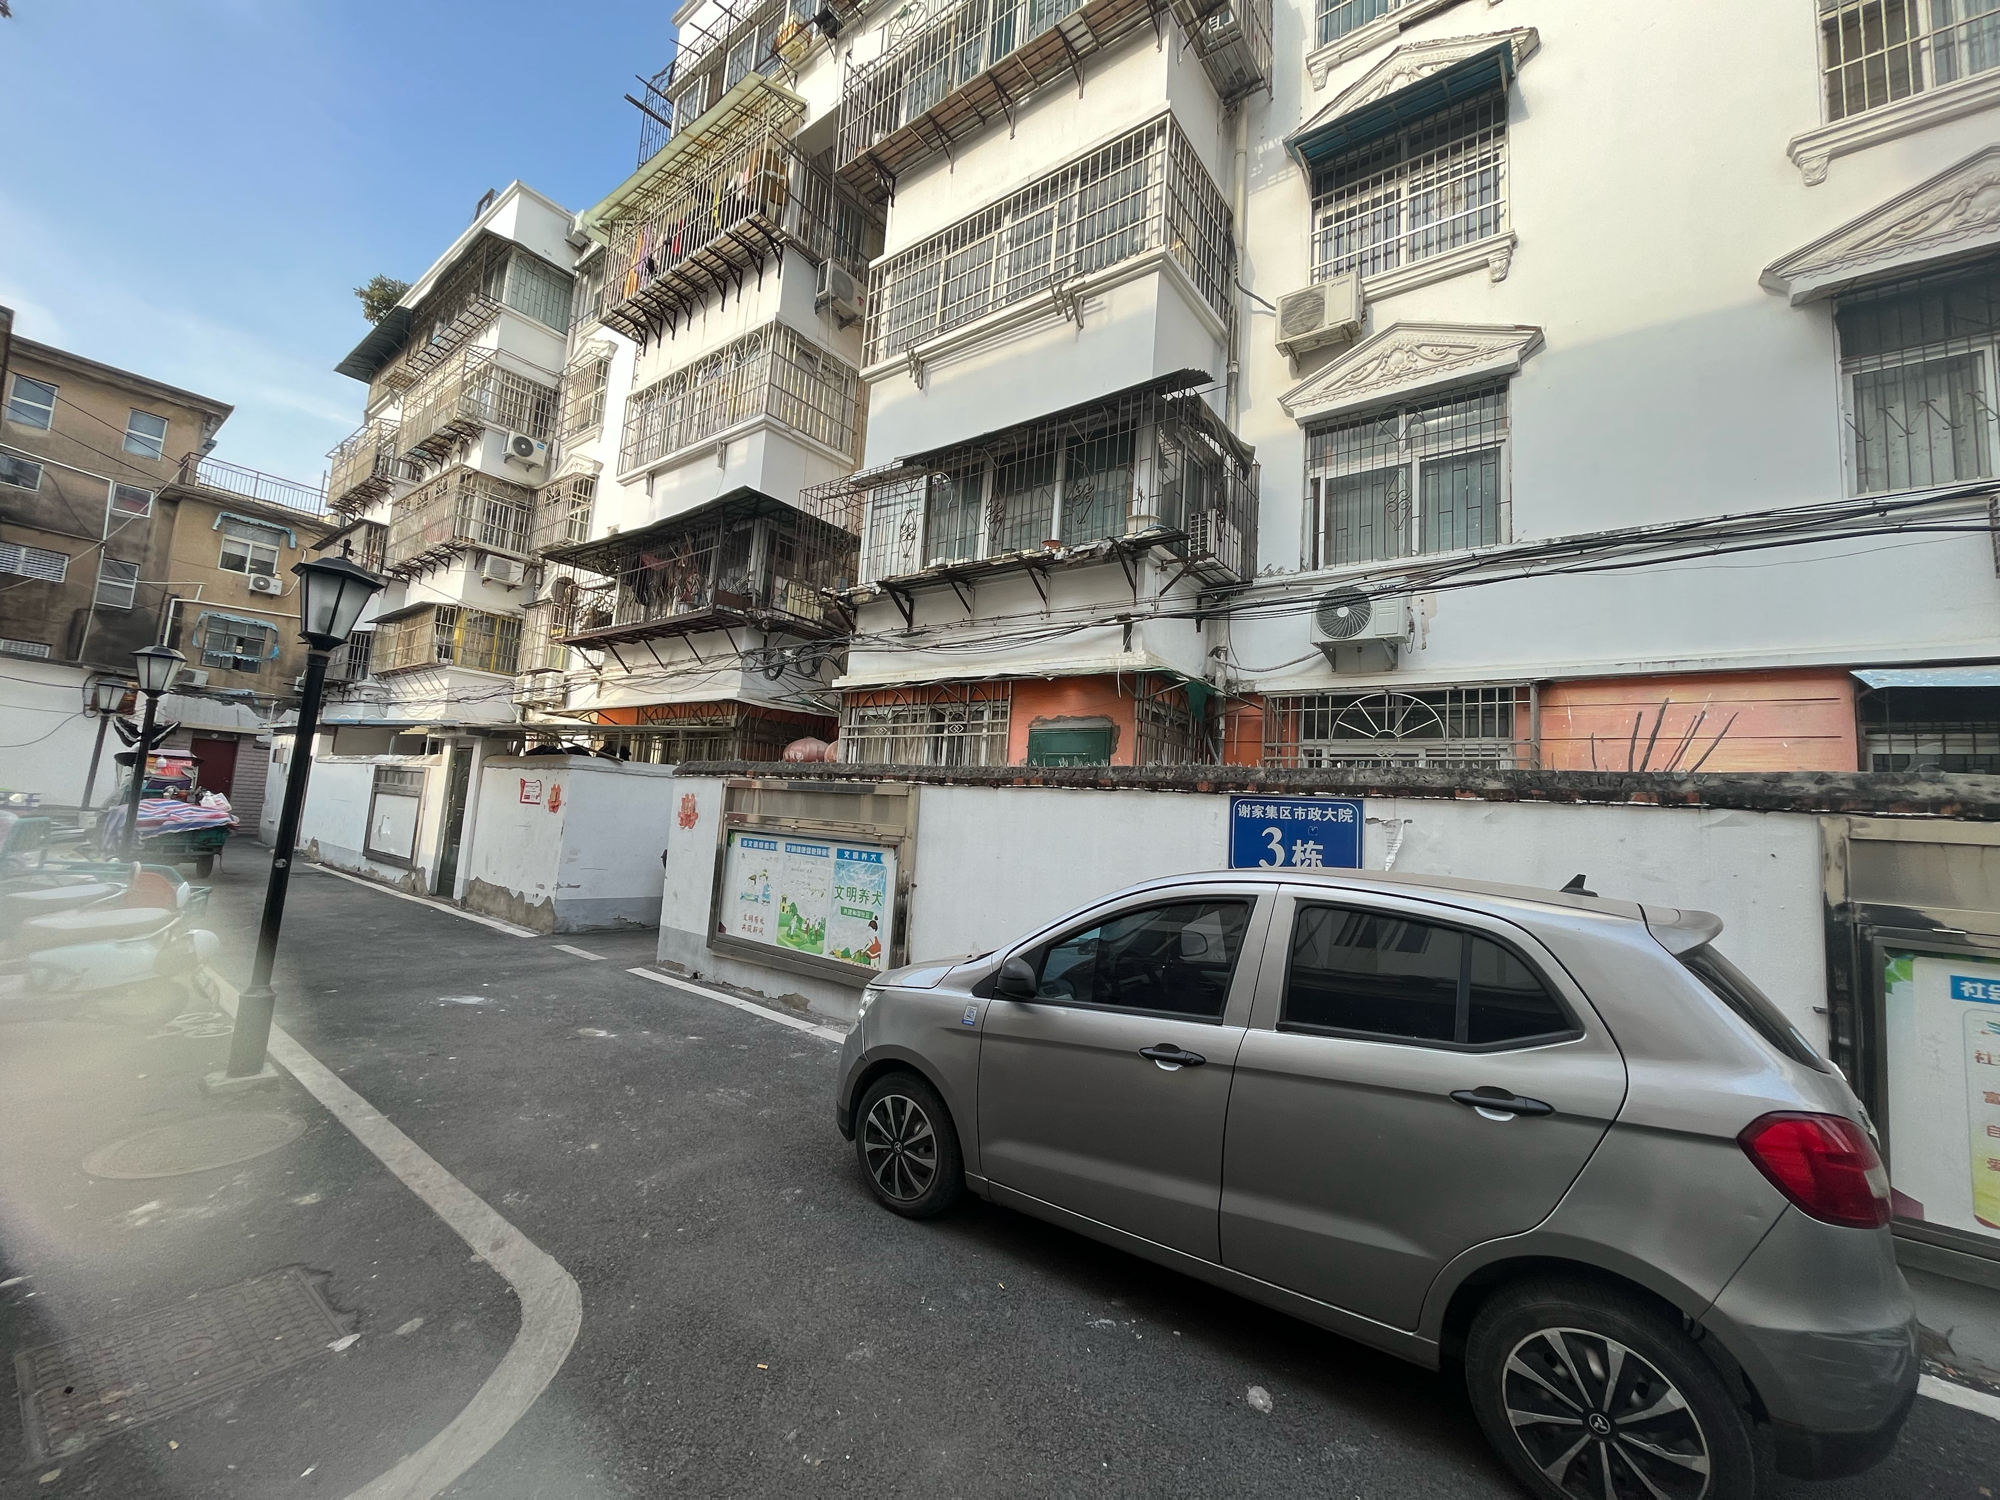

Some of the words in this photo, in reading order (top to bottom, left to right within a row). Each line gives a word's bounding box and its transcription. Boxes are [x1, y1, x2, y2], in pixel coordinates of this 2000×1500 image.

[1237, 804, 1354, 823] 谢家集区市政大院
[844, 851, 877, 862] 文明养犬
[834, 885, 883, 907] 文明养犬
